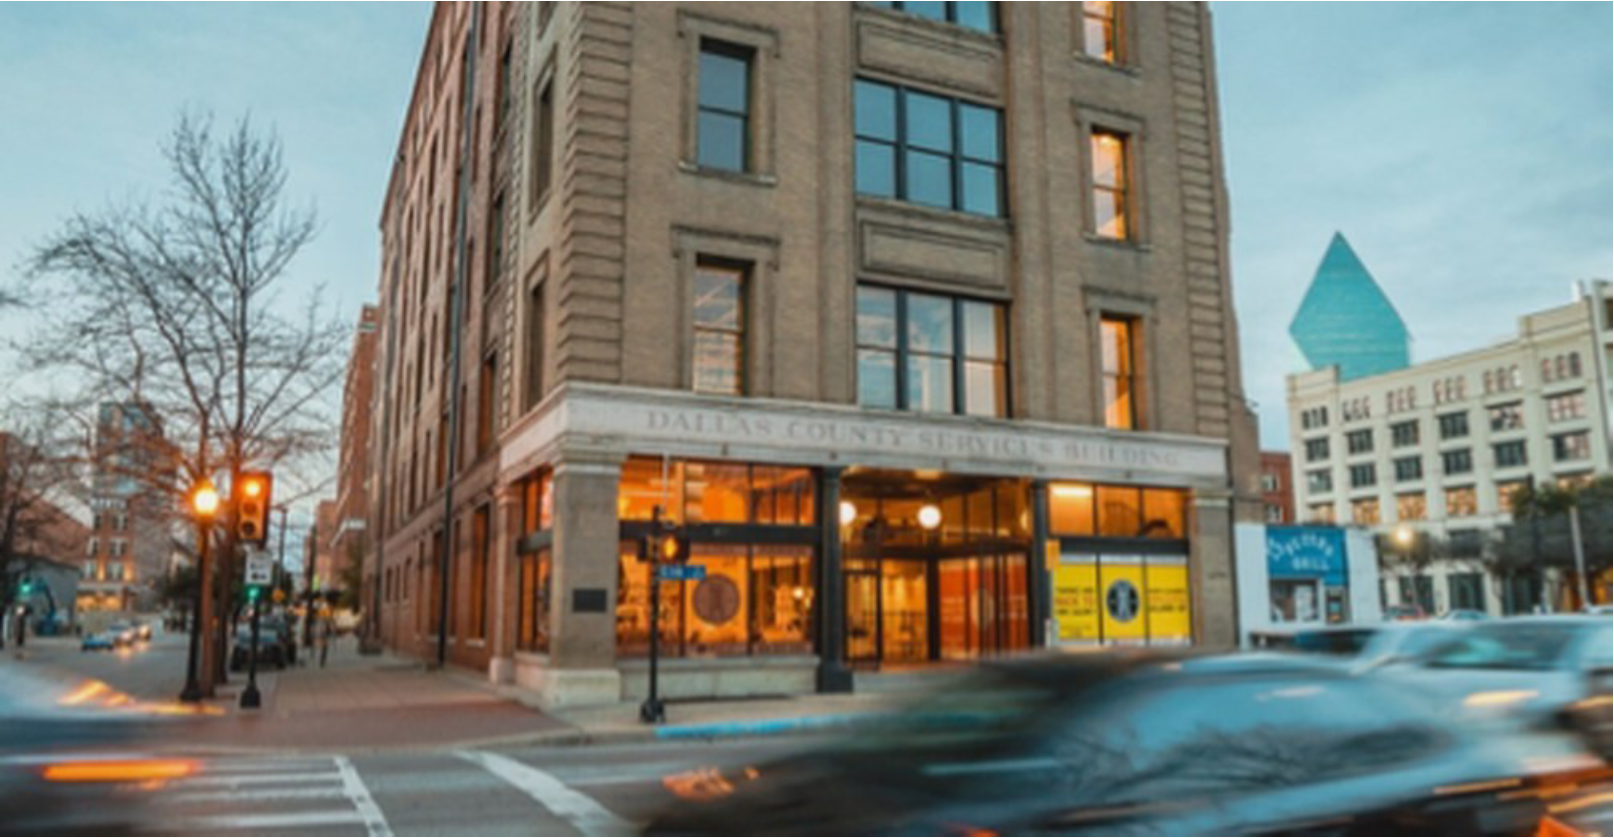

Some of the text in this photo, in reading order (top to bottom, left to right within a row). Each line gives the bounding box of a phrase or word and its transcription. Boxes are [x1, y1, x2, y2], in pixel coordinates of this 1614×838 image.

[647, 409, 1180, 467] DALLAS COUNTY SERVICES BUILDING
